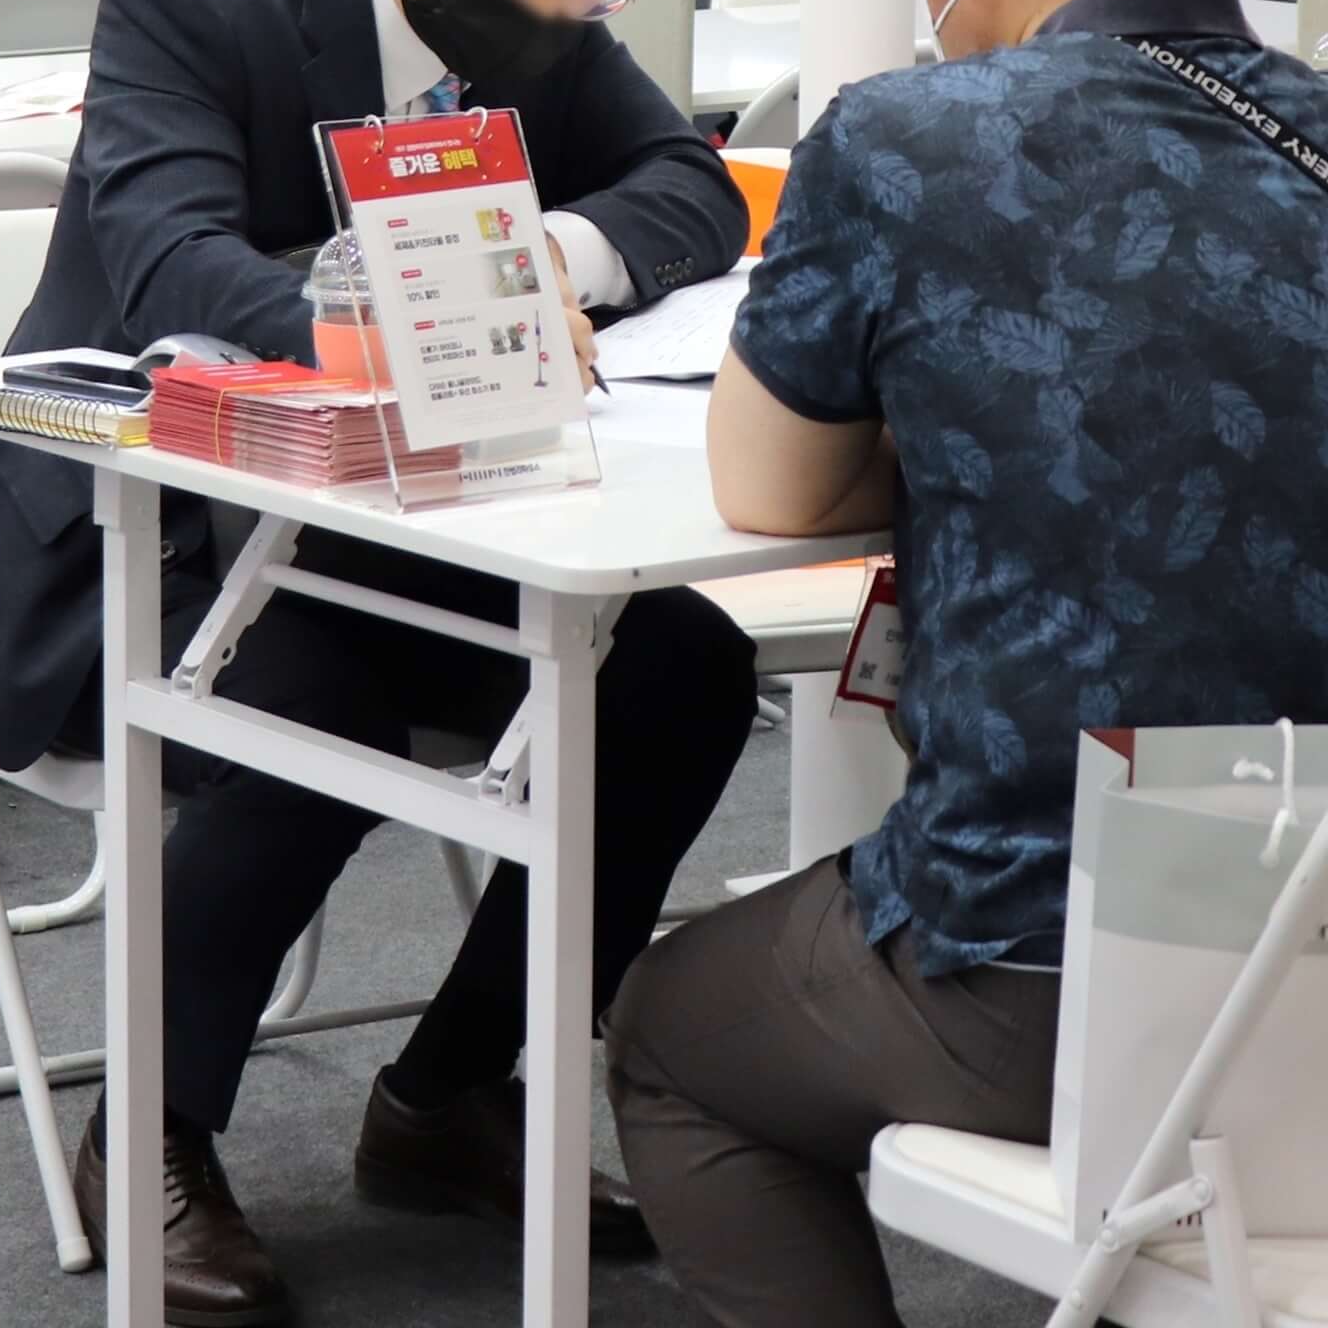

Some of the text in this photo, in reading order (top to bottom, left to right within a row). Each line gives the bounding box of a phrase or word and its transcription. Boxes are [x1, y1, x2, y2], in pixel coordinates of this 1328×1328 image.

[1138, 40, 1281, 139] EXPEDITION
[388, 147, 478, 177] 즐거운 혜택
